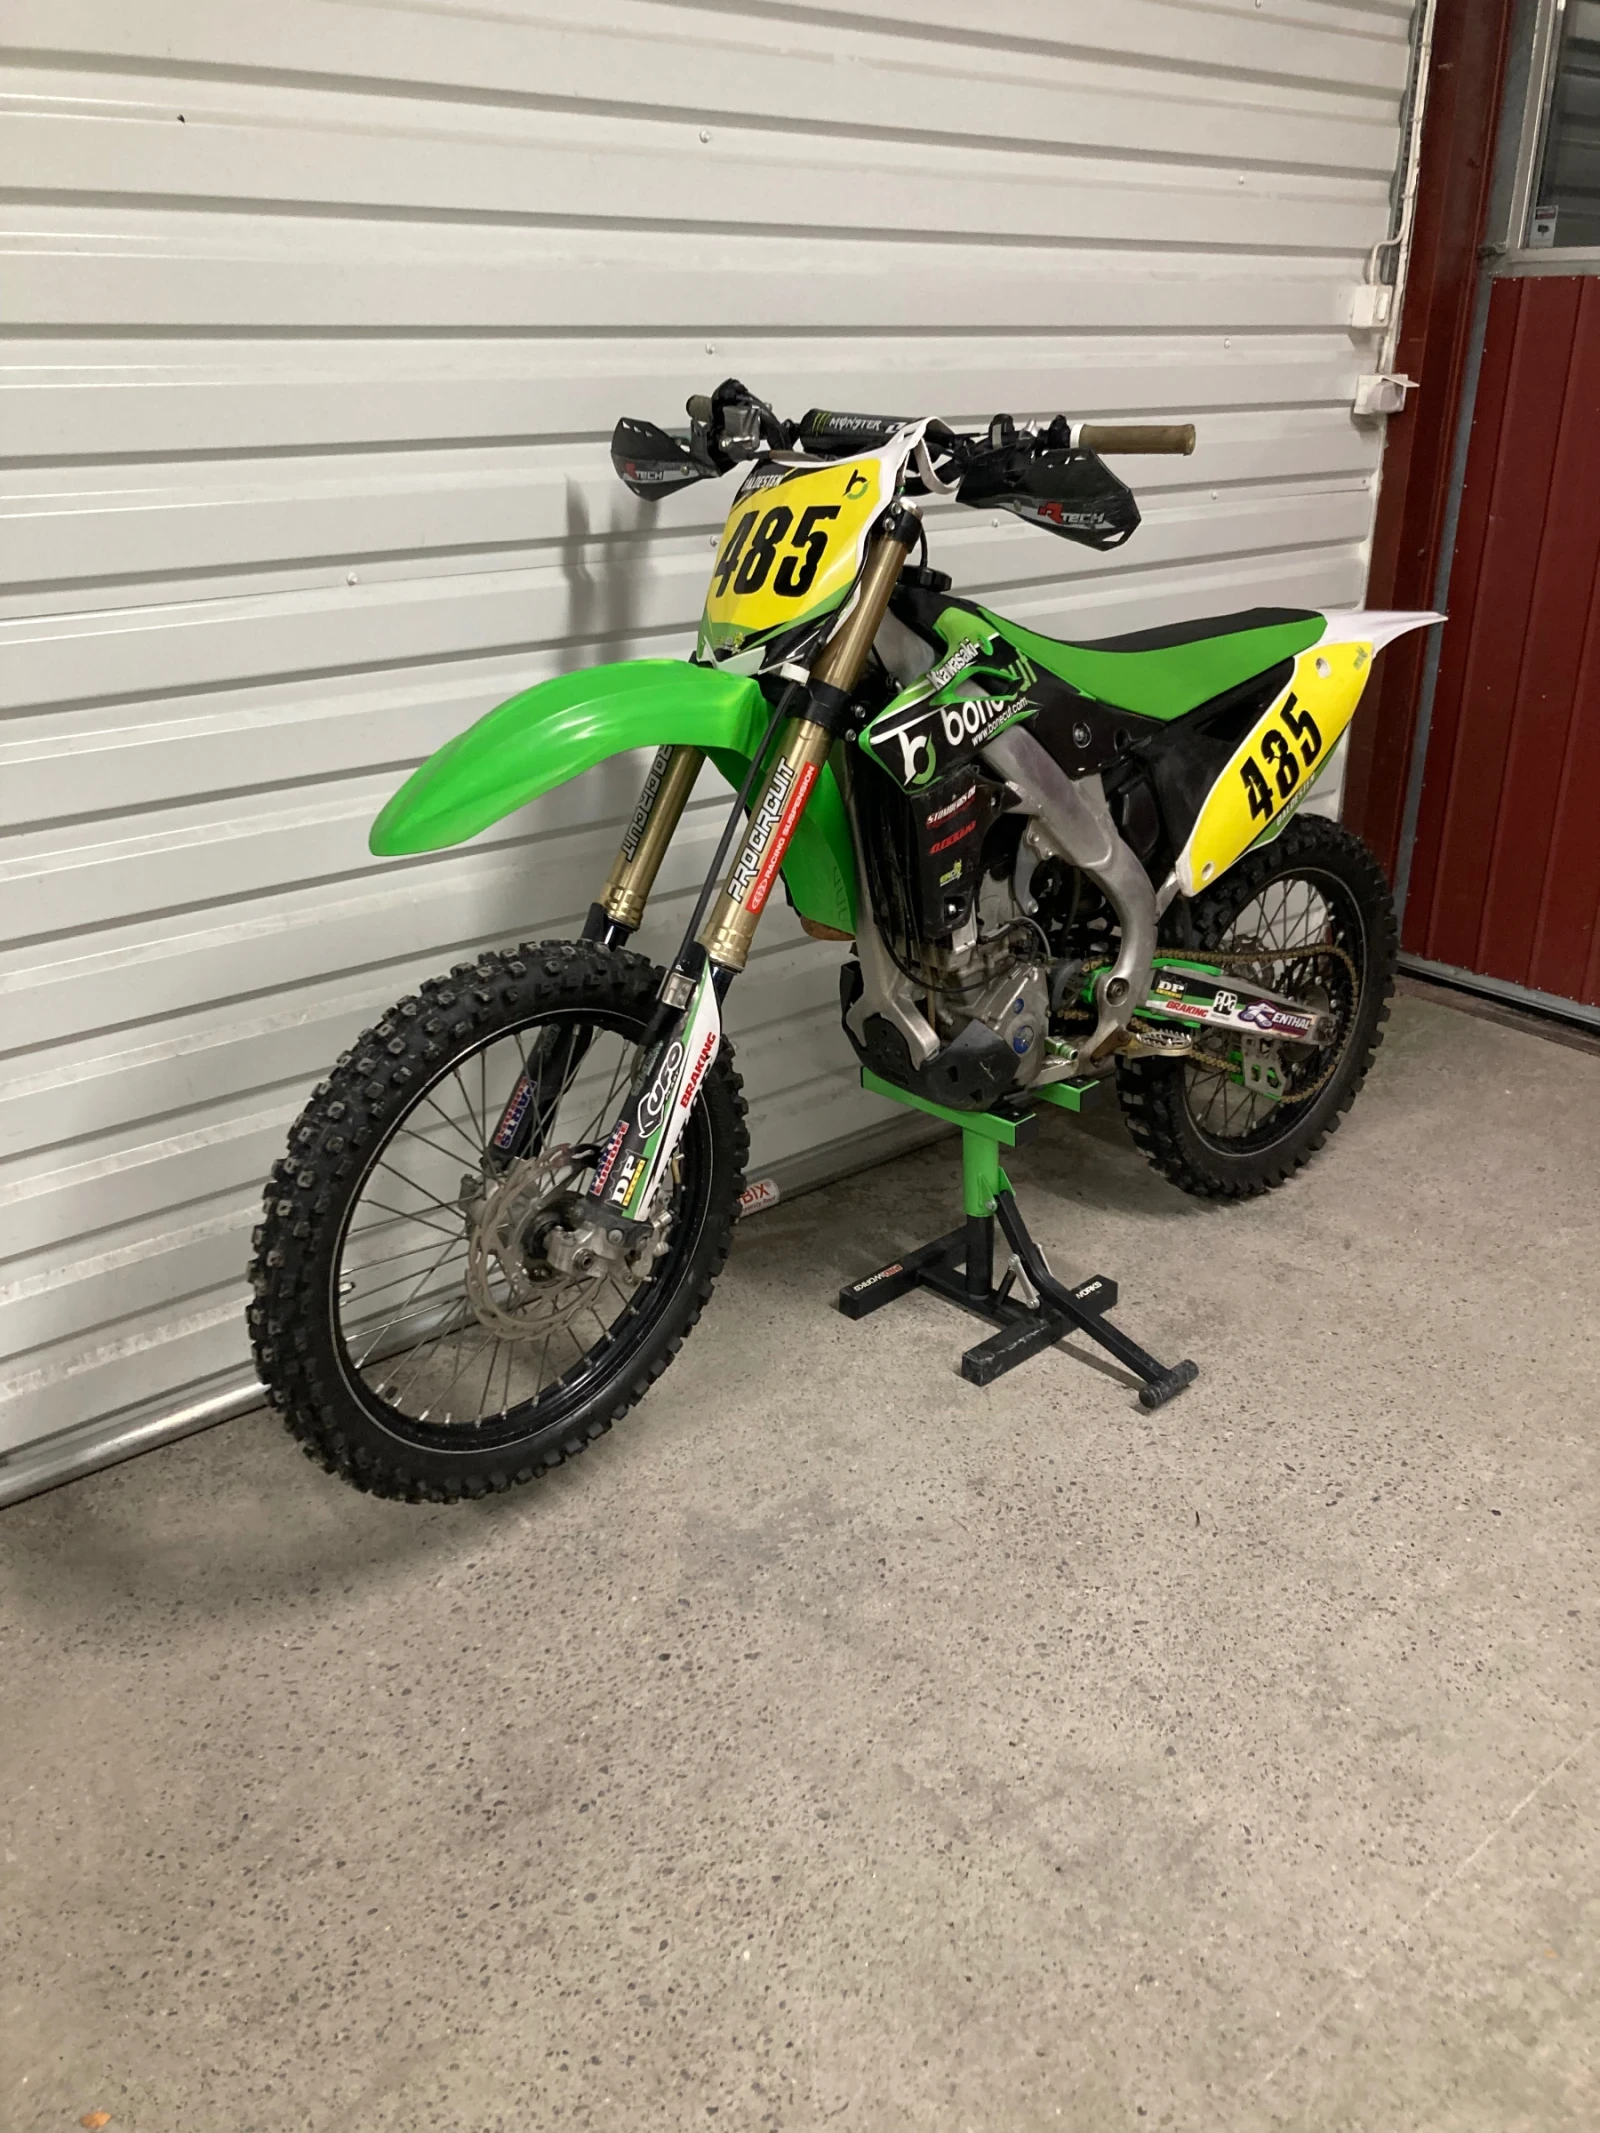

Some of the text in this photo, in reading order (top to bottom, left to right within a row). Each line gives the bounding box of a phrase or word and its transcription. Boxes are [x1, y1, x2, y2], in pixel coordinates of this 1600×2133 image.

[828, 416, 882, 432] MONSTER
[714, 505, 842, 598] 485
[926, 637, 980, 691] Kawasaki
[971, 697, 1029, 747] www.bonecut.com
[1239, 691, 1322, 822] 485
[621, 771, 662, 863] CIRCUIT
[727, 846, 760, 904] PRO
[748, 756, 794, 854] CIRCUIT
[765, 839, 786, 879] RACING
[782, 765, 815, 836] SUSPENSION
[1158, 980, 1185, 993] DP
[1166, 1000, 1209, 1018] BRAKING
[680, 1031, 716, 1109] BRAKING
[612, 1154, 636, 1205] DP
